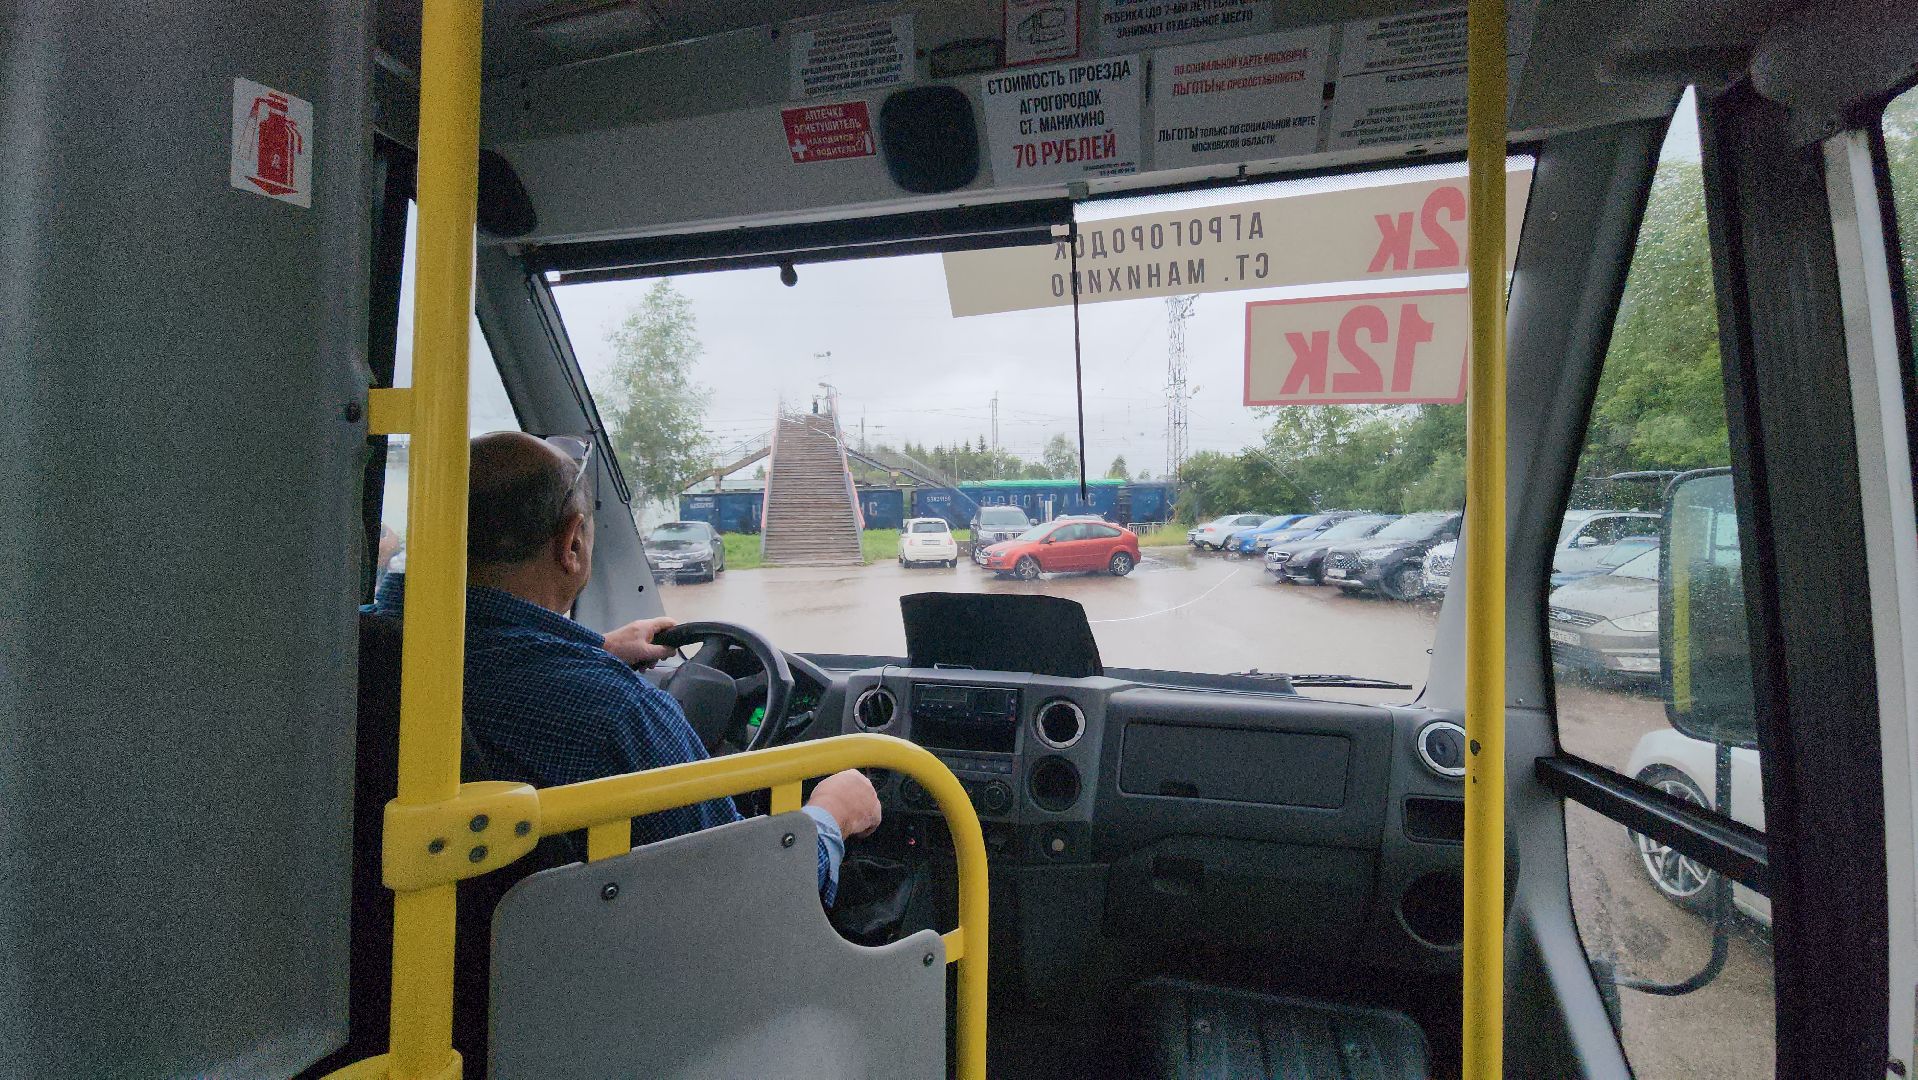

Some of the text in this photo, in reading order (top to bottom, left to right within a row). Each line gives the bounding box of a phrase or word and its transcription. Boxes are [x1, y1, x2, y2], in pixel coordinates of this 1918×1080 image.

[988, 60, 1131, 95] СТОИМОСТЬ ПРОЕЗДА
[1173, 79, 1215, 96] ЛЬГОТЫ
[804, 107, 844, 121] АПТЕЧКА
[1020, 89, 1102, 116] АГРОГОРОДОК
[793, 118, 862, 135] ОГНЕТУШИТЕЛЬ
[1020, 110, 1105, 135] СТ. МАНИХИНО
[1158, 115, 1317, 142] ЛЬГОТЫ ТОЛЬКО ПО СОЦИАЛЬНОЙ КАРТЕ
[1013, 128, 1116, 168] 70 РУБЛЕЙ
[1191, 138, 1240, 153] МОСКОВСКОЙ
